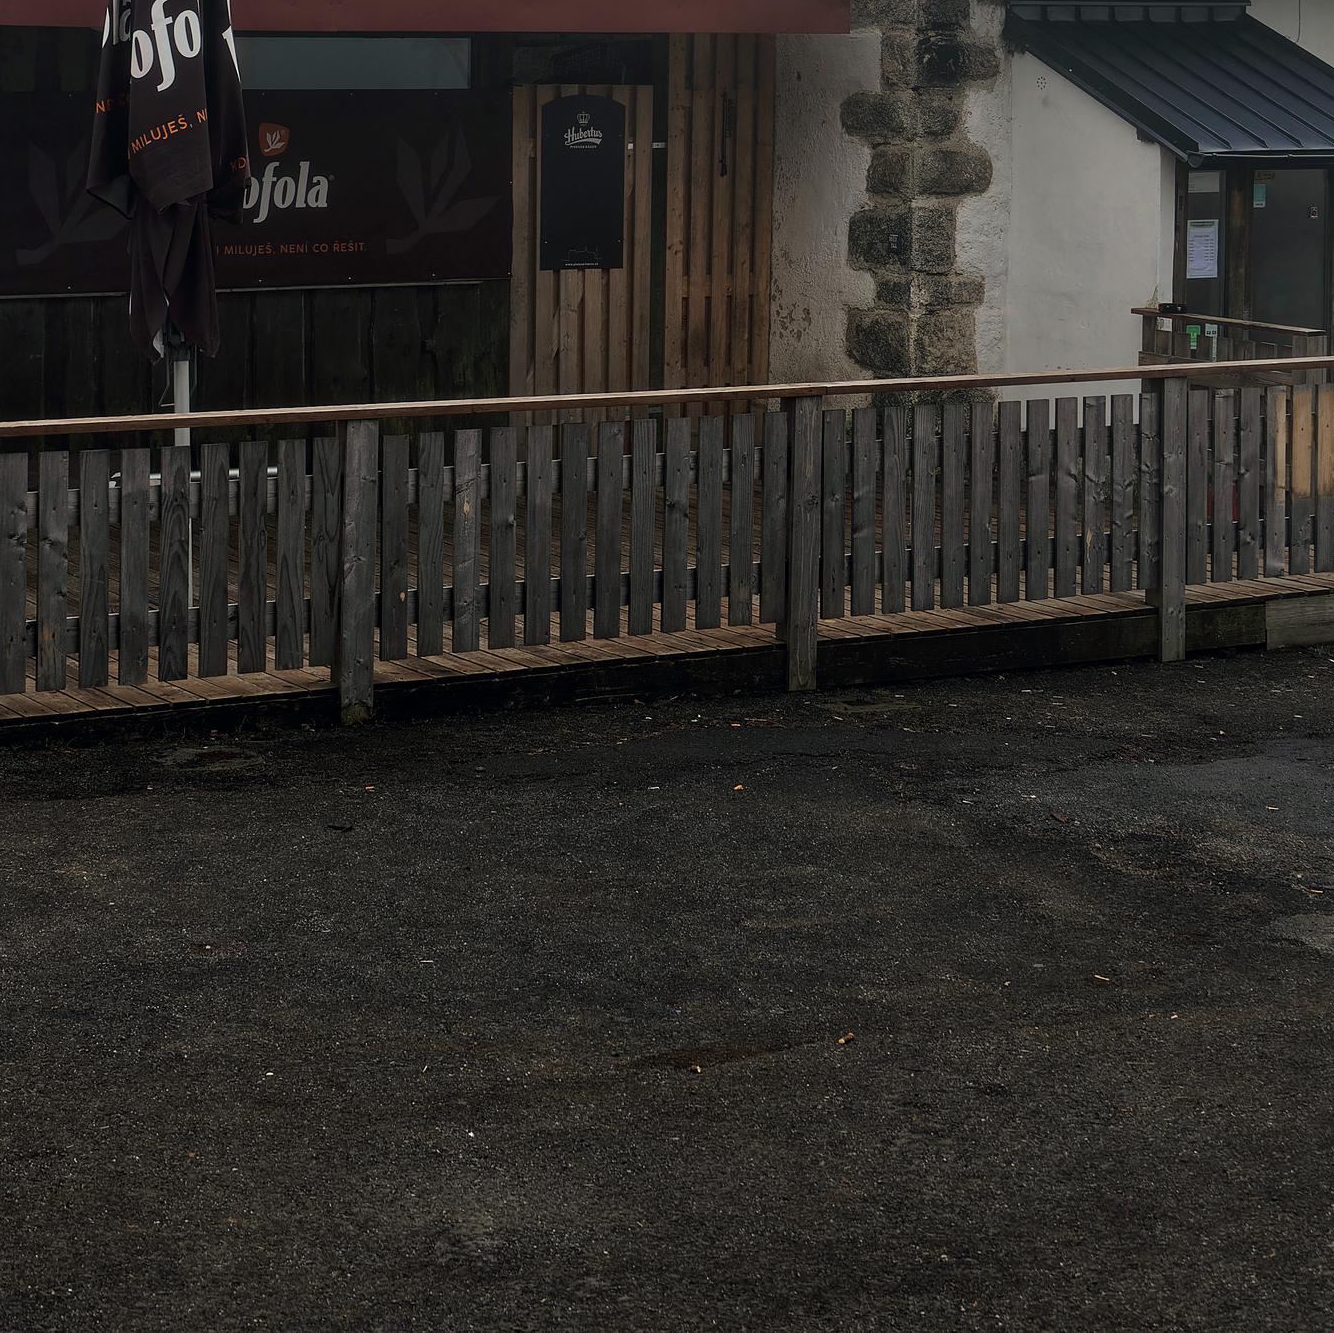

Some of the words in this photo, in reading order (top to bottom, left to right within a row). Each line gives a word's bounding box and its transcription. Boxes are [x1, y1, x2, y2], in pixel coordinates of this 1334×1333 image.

[564, 126, 603, 142] Hubertus
[242, 161, 328, 223] ofola
[224, 242, 276, 256] MILUJEŠ,
[280, 241, 308, 254] NENÍ
[313, 243, 329, 253] CO
[333, 240, 367, 252] ŘEŠIT.
